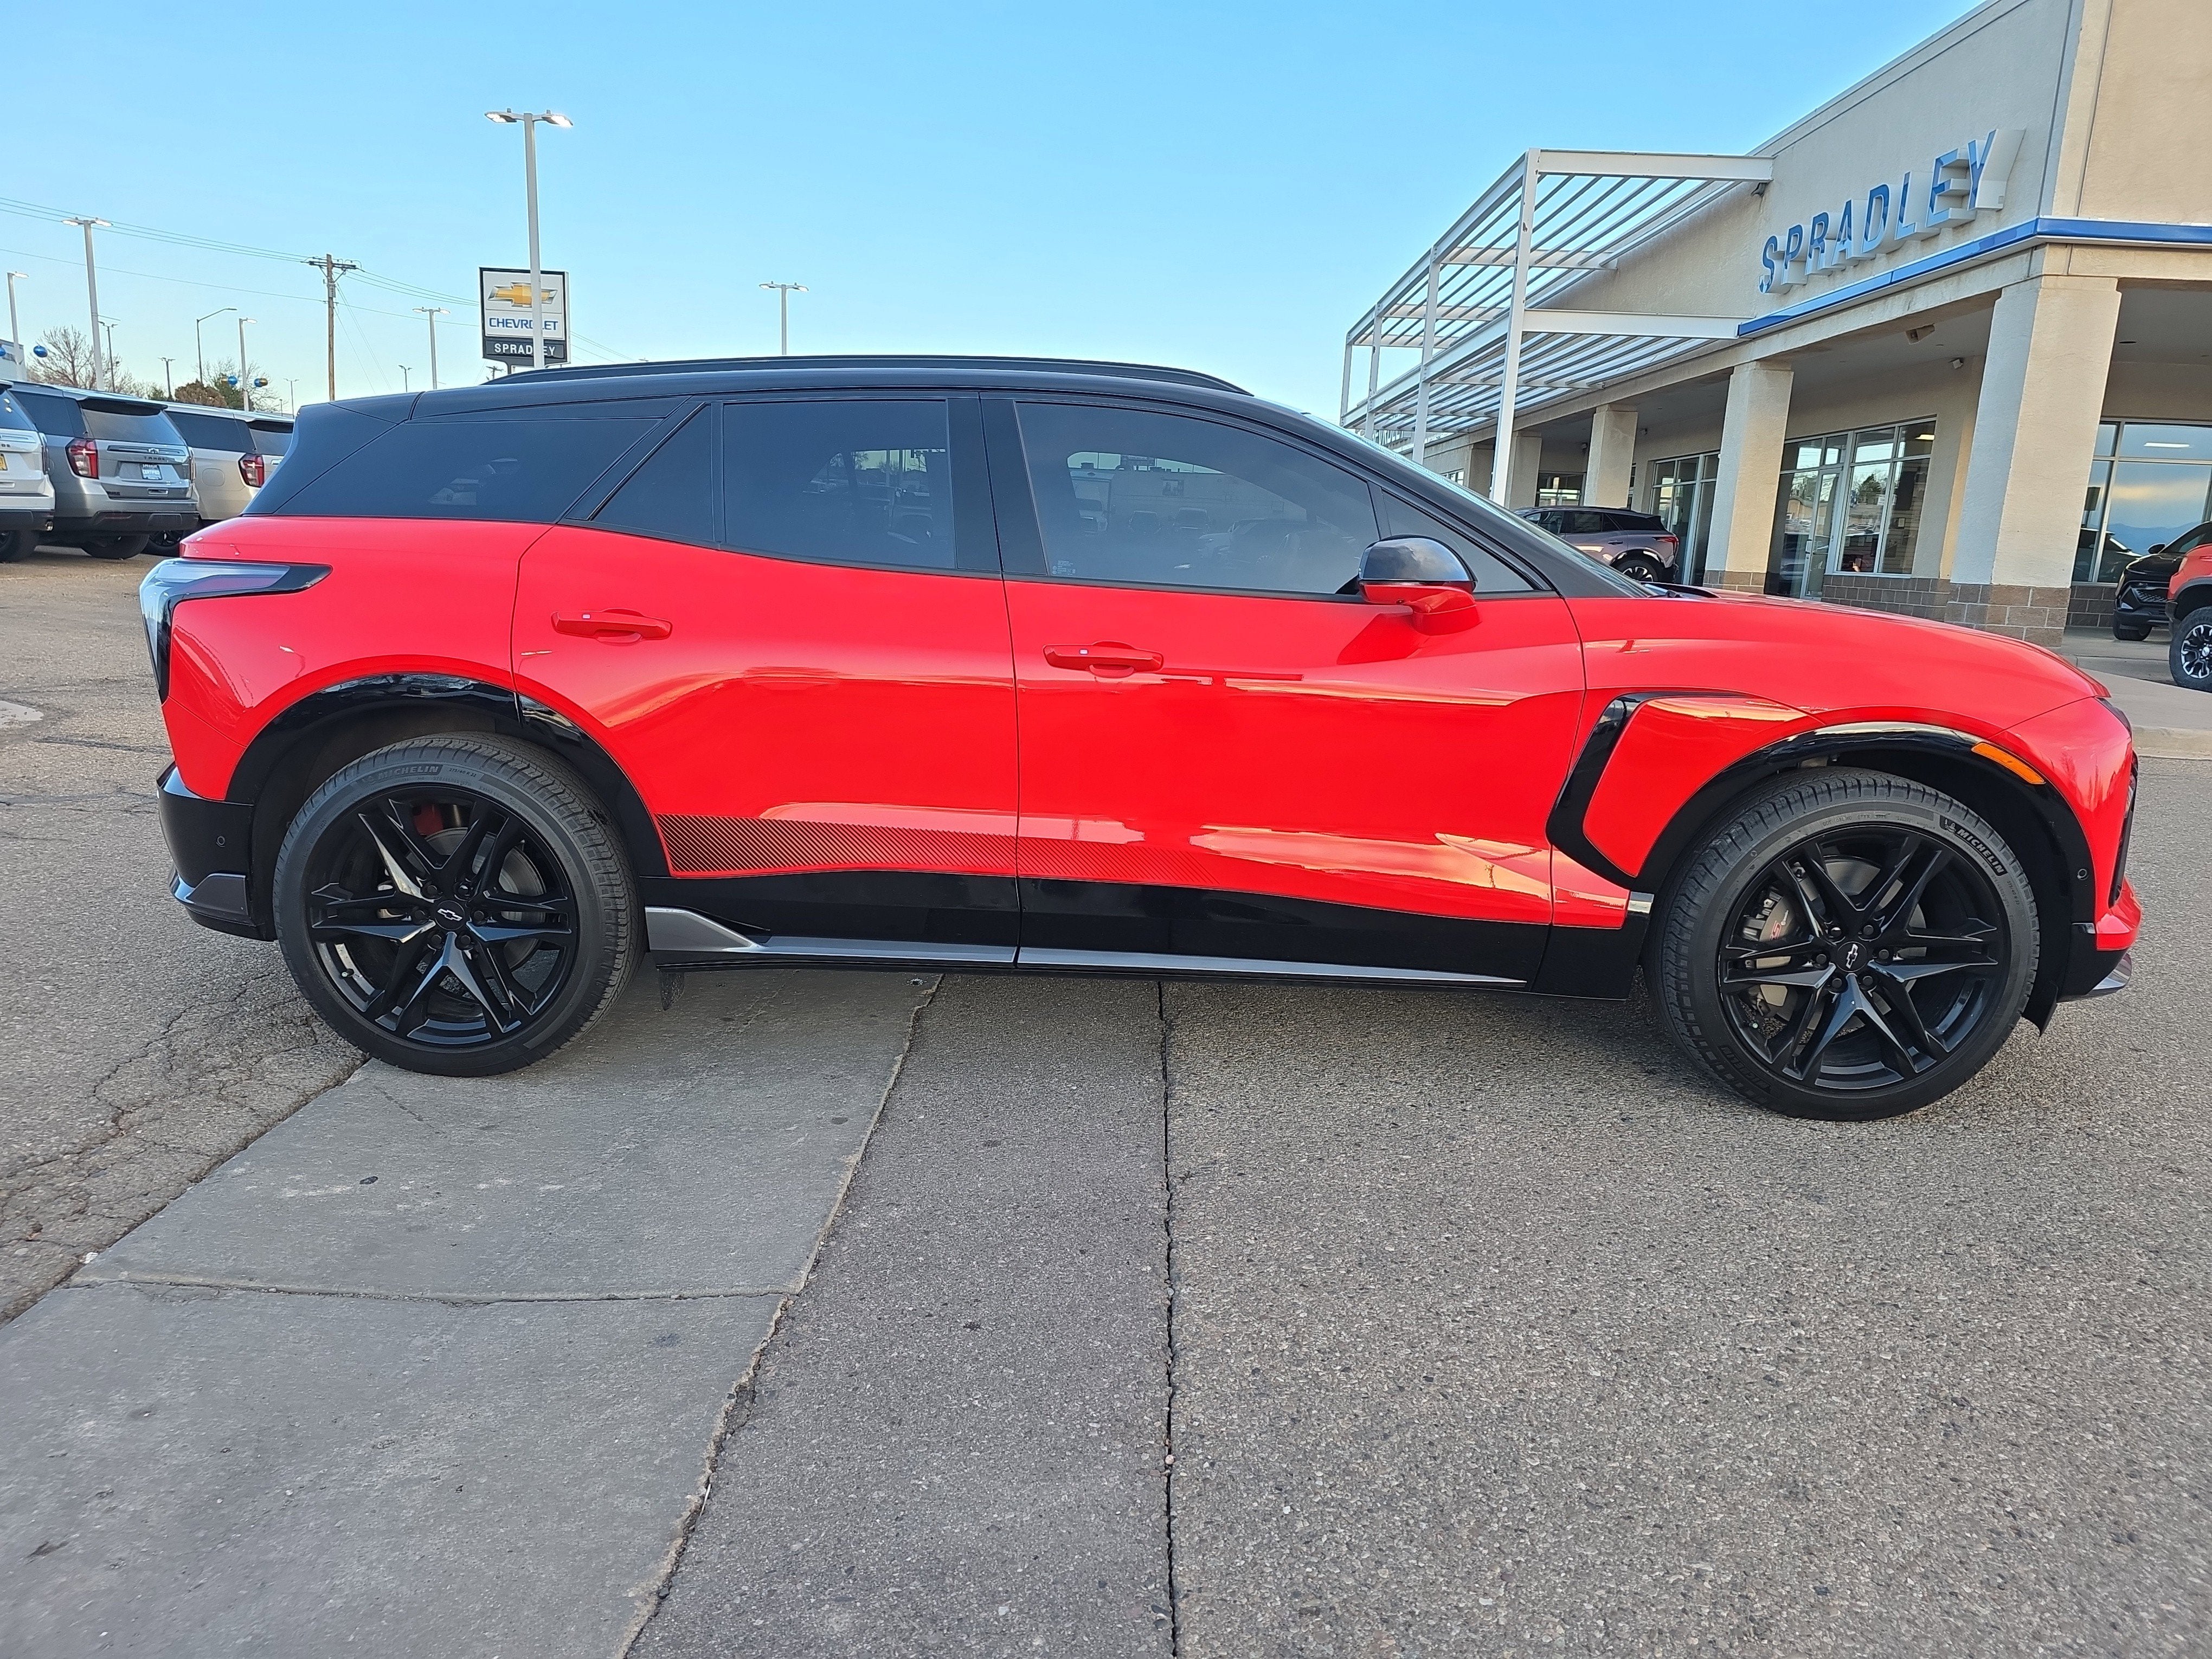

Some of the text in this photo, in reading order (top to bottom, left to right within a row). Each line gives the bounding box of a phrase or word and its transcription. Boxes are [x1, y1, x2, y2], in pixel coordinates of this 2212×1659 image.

[1758, 128, 2001, 294] SPRADLEY
[489, 318, 558, 331] CHEVRET
[494, 343, 556, 356] SPRADEY
[378, 766, 439, 780] MICHELIN
[1957, 828, 2005, 874] MICHELIN
